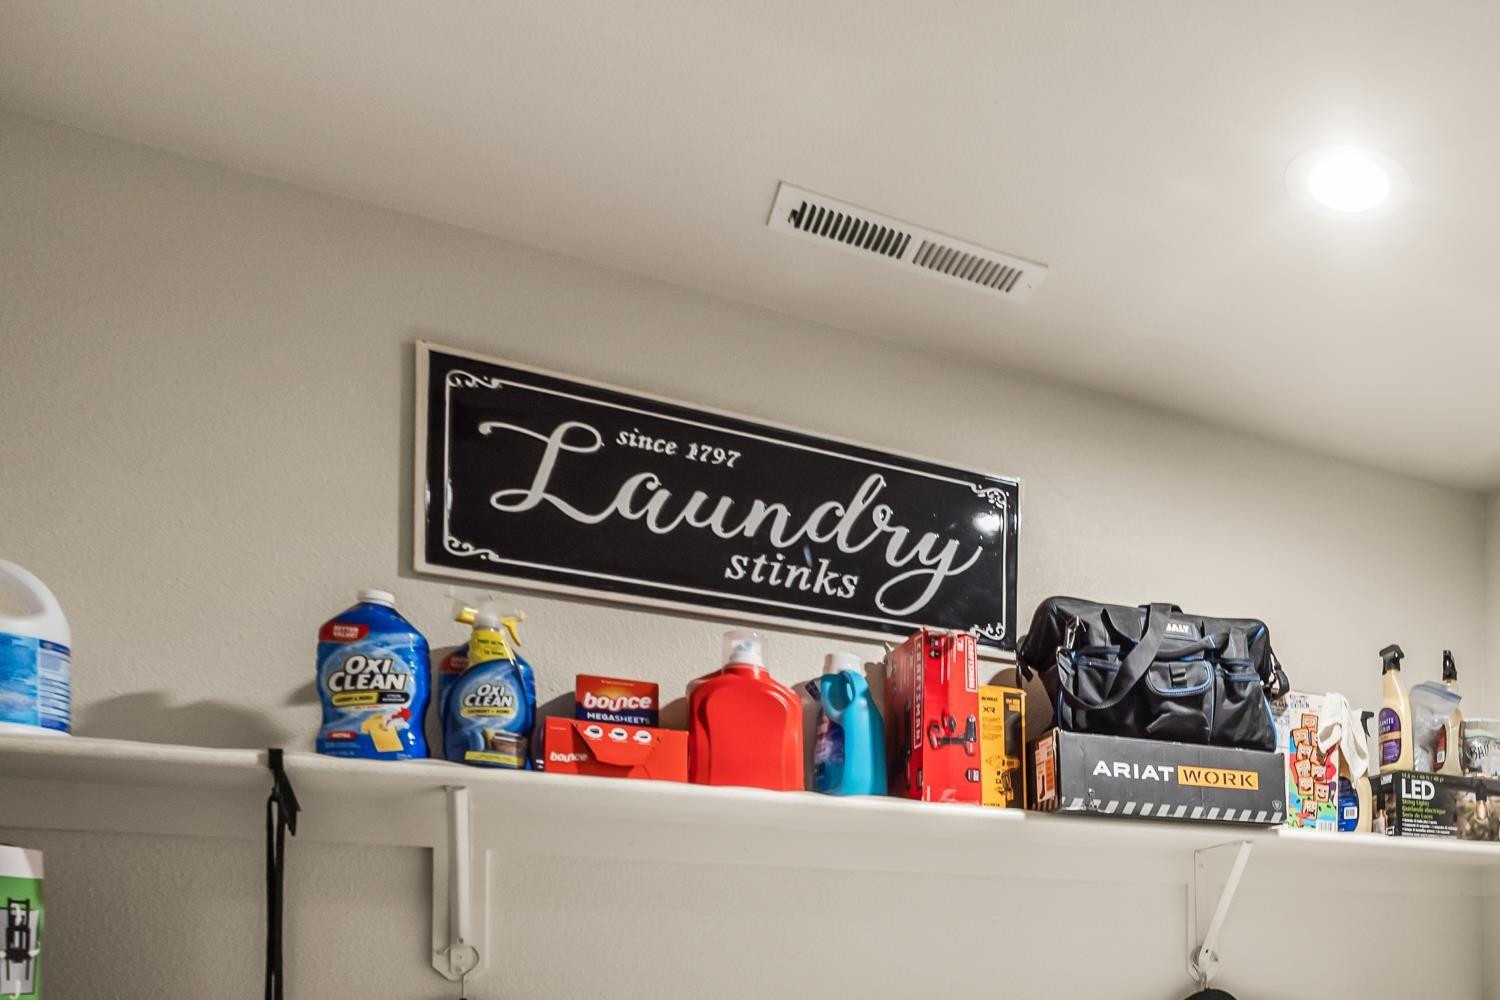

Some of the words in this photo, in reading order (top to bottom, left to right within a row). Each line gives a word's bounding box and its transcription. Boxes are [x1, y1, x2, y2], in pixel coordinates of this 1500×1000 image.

[616, 428, 677, 457] since
[688, 443, 742, 469] 1797
[478, 421, 983, 616] Laundry
[725, 551, 859, 600] stinks
[344, 655, 394, 676] OXI
[327, 671, 407, 693] CLEAN
[476, 683, 505, 697] OXI
[914, 641, 922, 741] CRAFTSMAN
[463, 694, 512, 707] CLEAN
[583, 691, 652, 711] bounce
[587, 712, 651, 725] MEGASHEETS
[550, 751, 588, 763] bounce
[1092, 759, 1174, 782] ARIAT
[1181, 768, 1253, 787] WORK
[1401, 778, 1435, 801] LED
